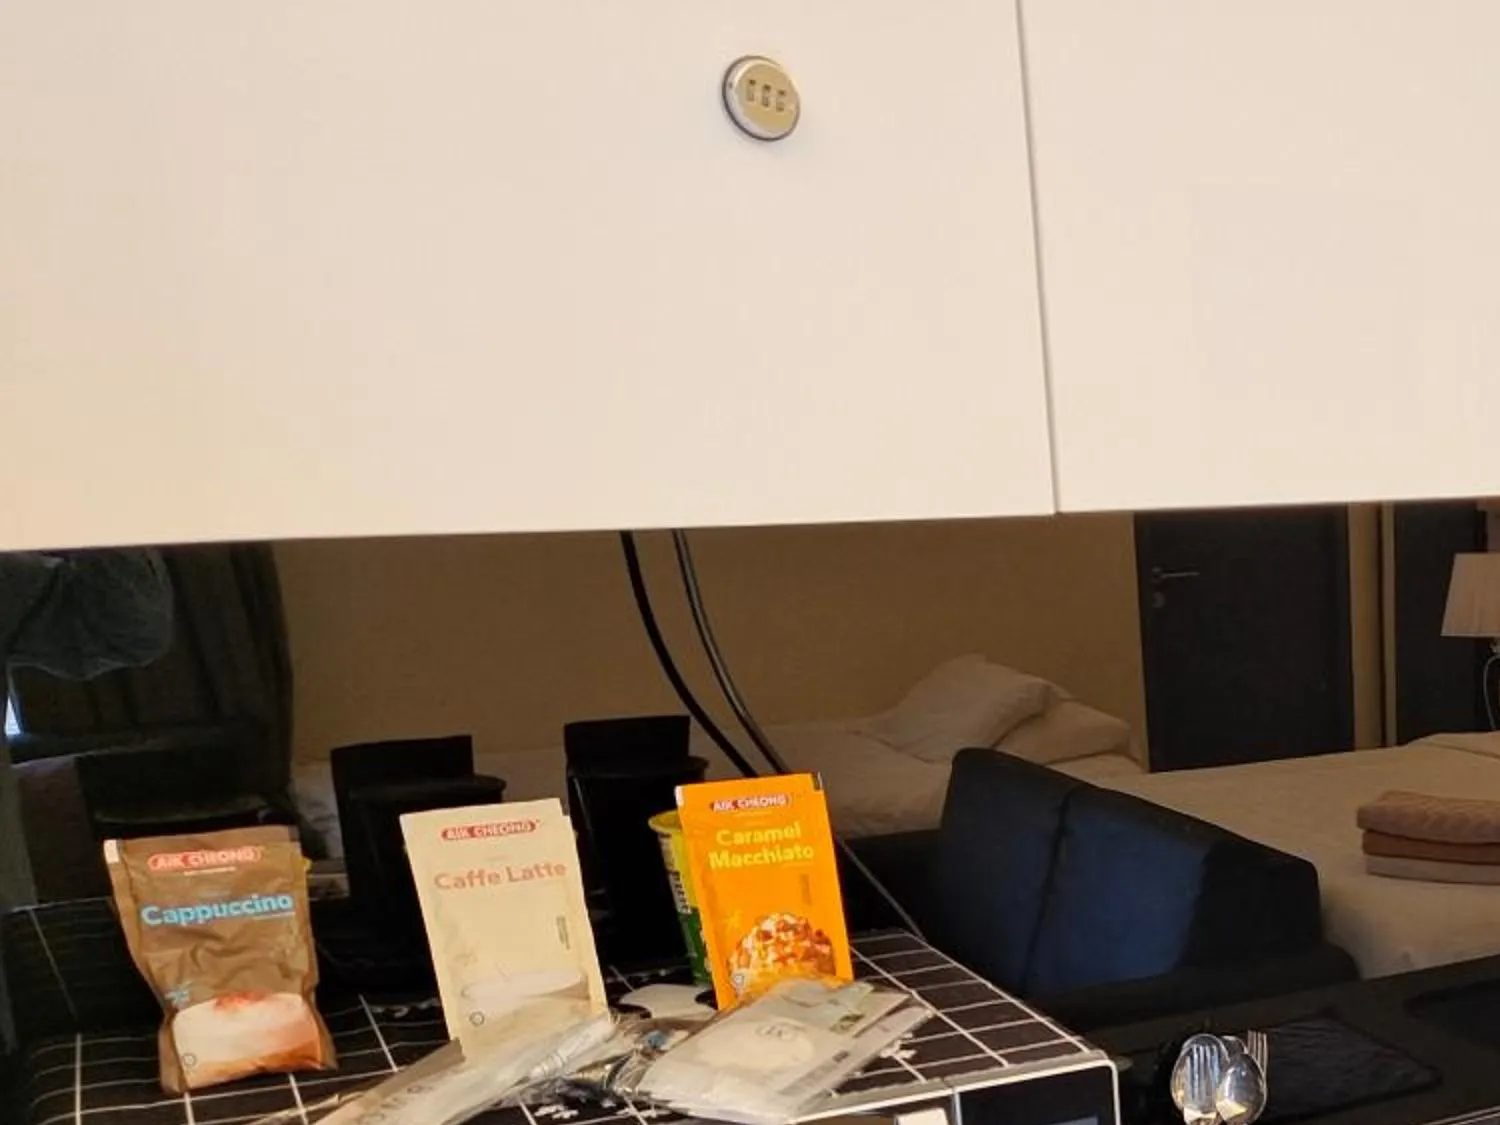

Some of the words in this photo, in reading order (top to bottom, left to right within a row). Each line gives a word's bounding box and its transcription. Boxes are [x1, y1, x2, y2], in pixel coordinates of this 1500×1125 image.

[715, 820, 802, 845] Caramel
[708, 844, 815, 870] Macchiato
[434, 867, 500, 890] Caffe
[505, 861, 567, 883] Latte
[141, 894, 293, 927] Cappuccino
